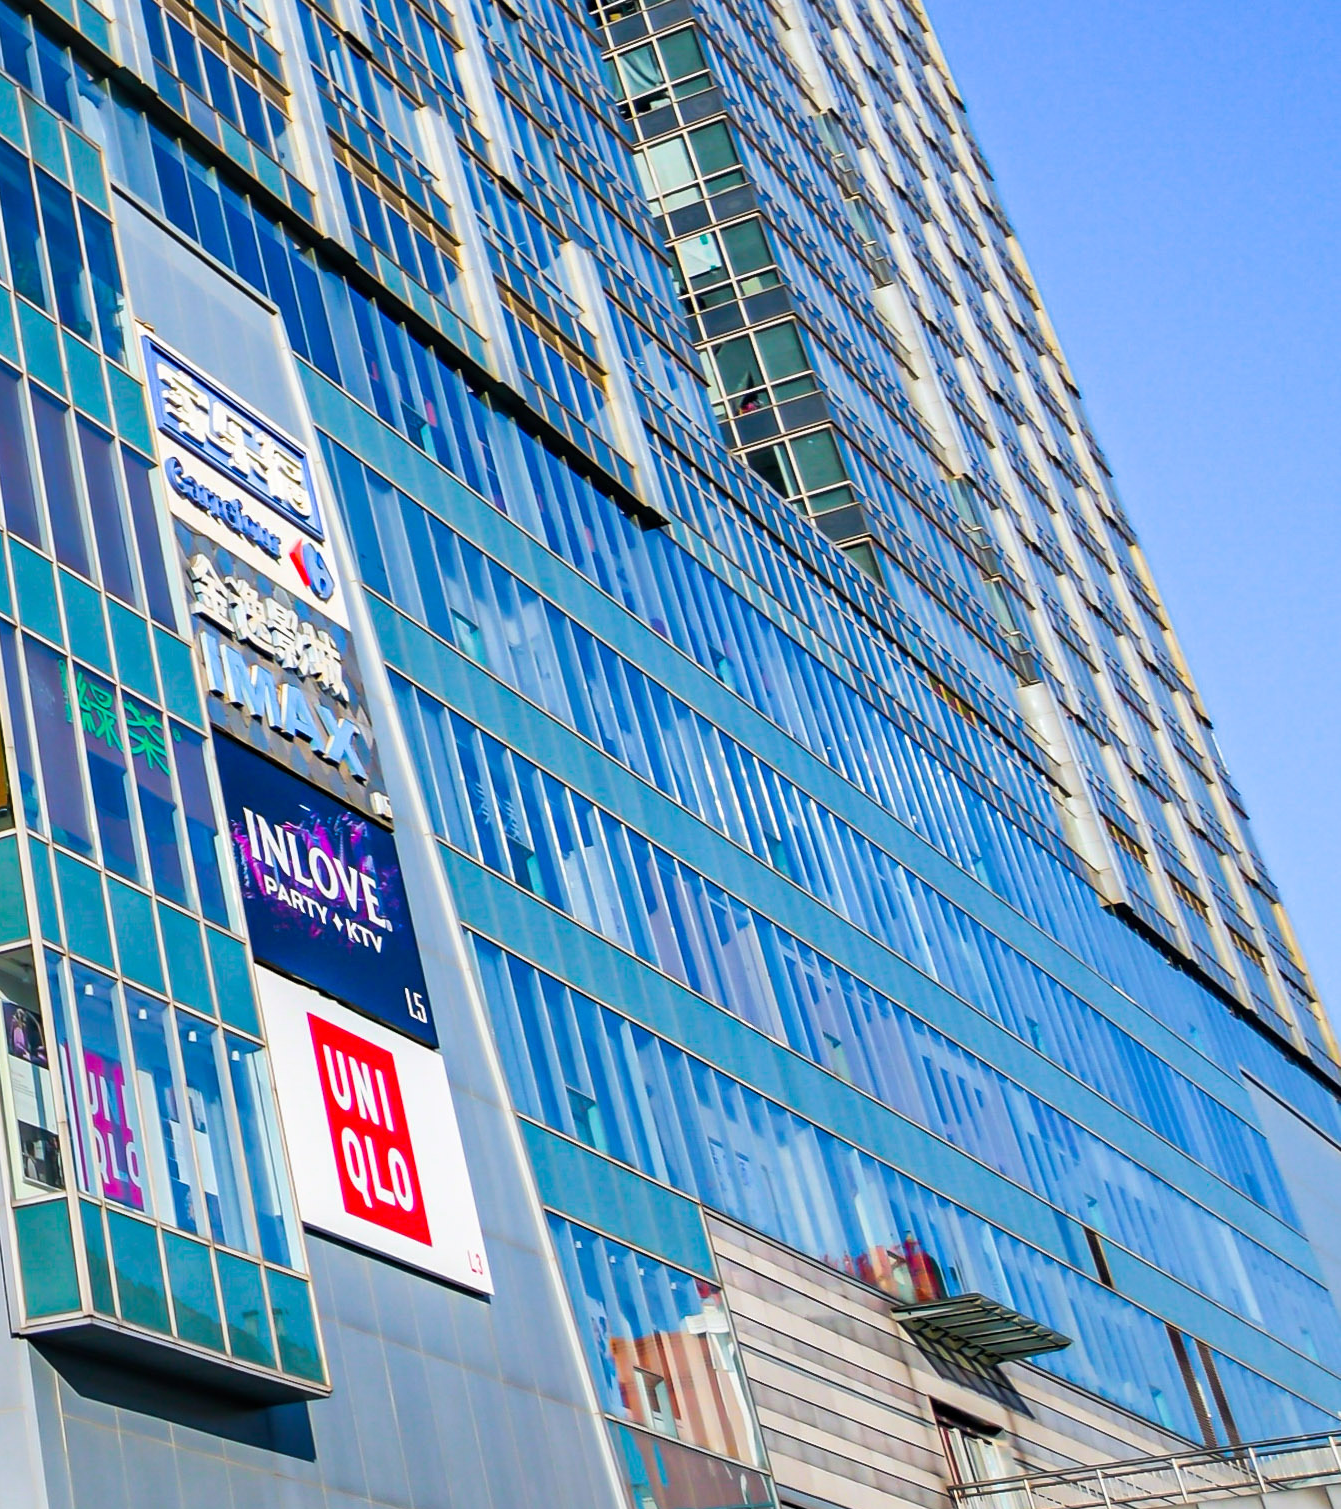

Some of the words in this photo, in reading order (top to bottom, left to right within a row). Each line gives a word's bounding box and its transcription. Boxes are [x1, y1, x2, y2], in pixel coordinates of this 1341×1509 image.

[200, 630, 369, 784] IMAX
[264, 873, 328, 926] PARTY
[346, 916, 383, 954] KTV
[404, 987, 428, 1024] L5
[323, 1043, 394, 1133] UNI
[340, 1126, 415, 1213] QLO
[468, 1248, 484, 1276] L3
